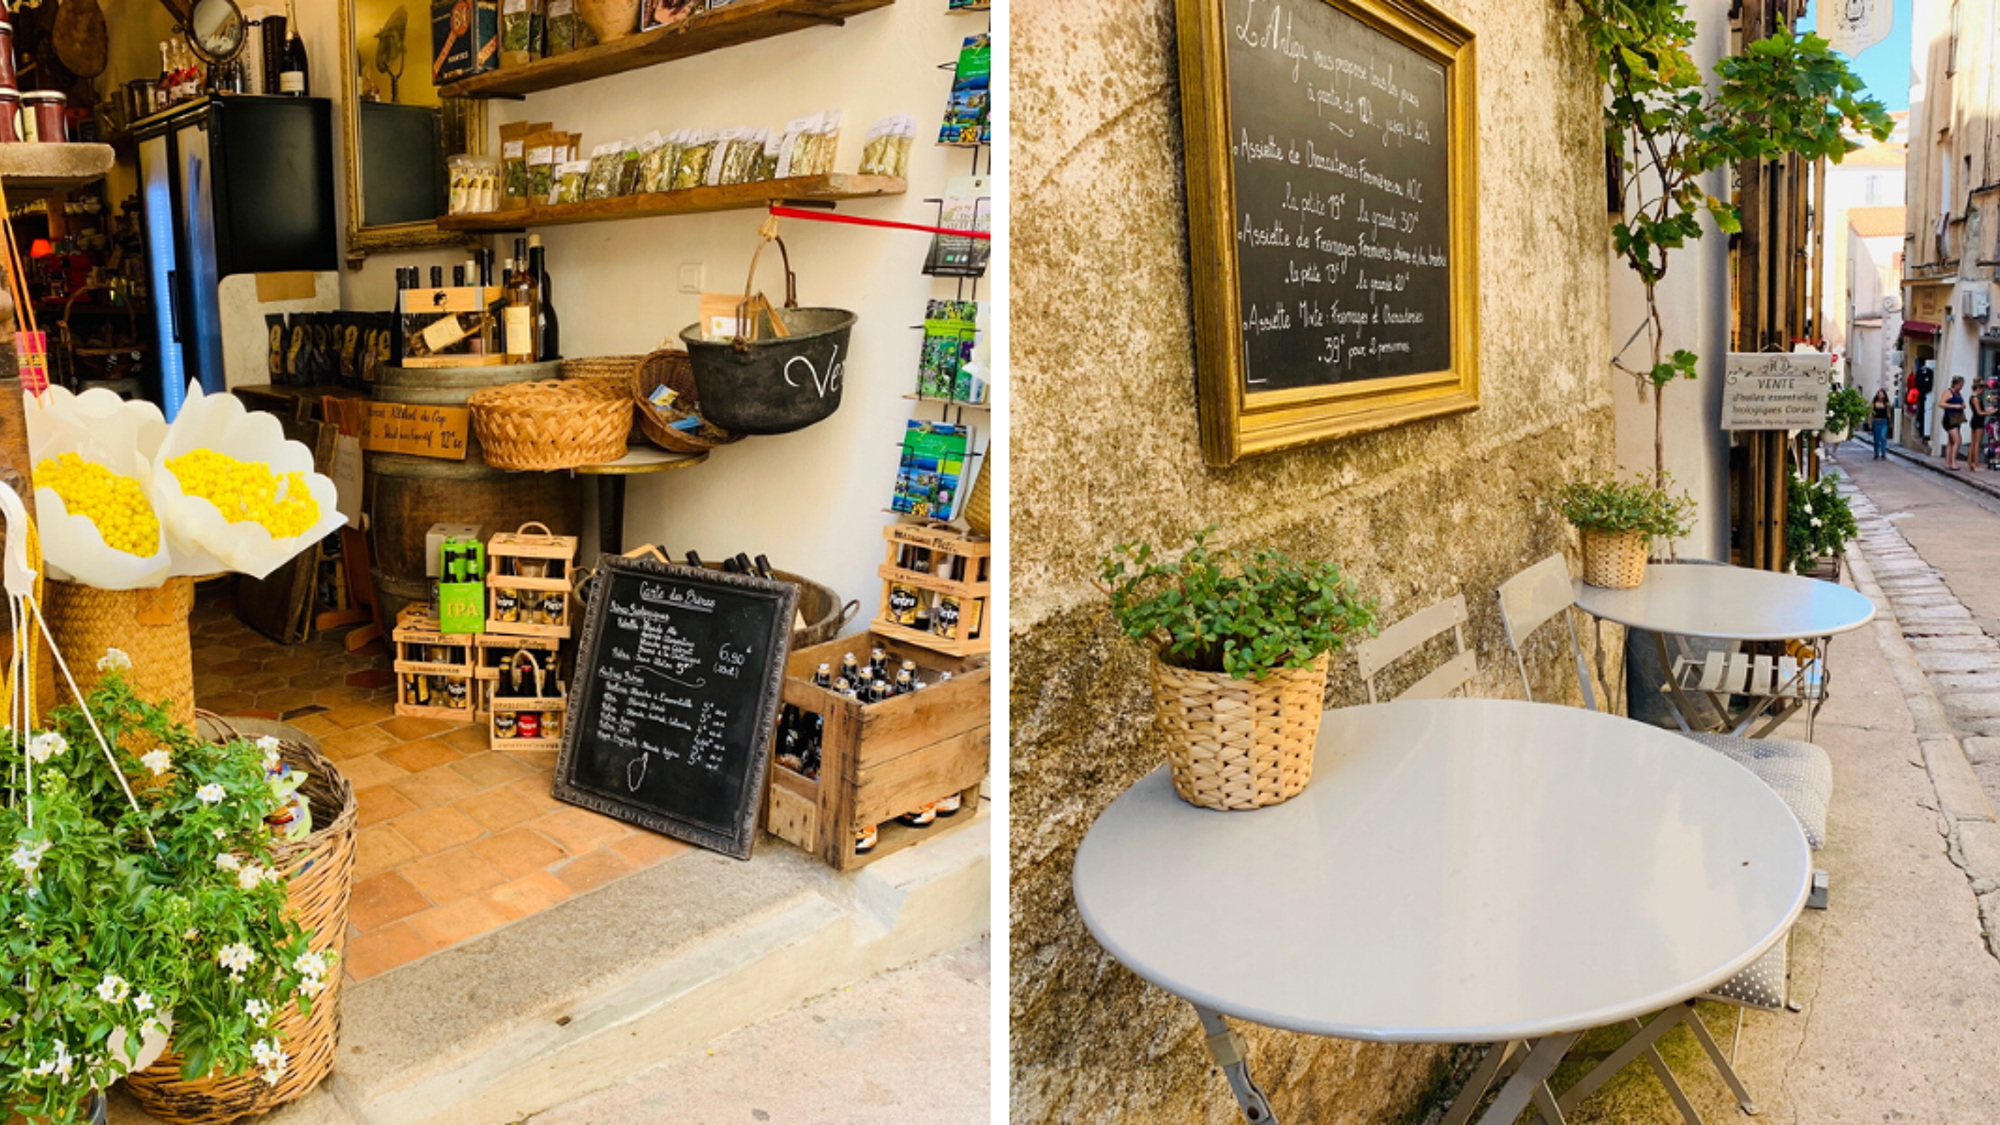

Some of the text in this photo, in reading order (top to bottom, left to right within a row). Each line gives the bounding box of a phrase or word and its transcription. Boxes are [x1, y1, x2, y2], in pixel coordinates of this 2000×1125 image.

[1241, 127, 1284, 164] Assiette
[1288, 138, 1301, 165] de
[1243, 212, 1291, 248] Assiette
[1295, 223, 1310, 249] de
[1249, 303, 1291, 336] Assiette
[784, 343, 845, 398] Ve
[1757, 378, 1796, 389] VENTE
[446, 602, 479, 618] IPA
